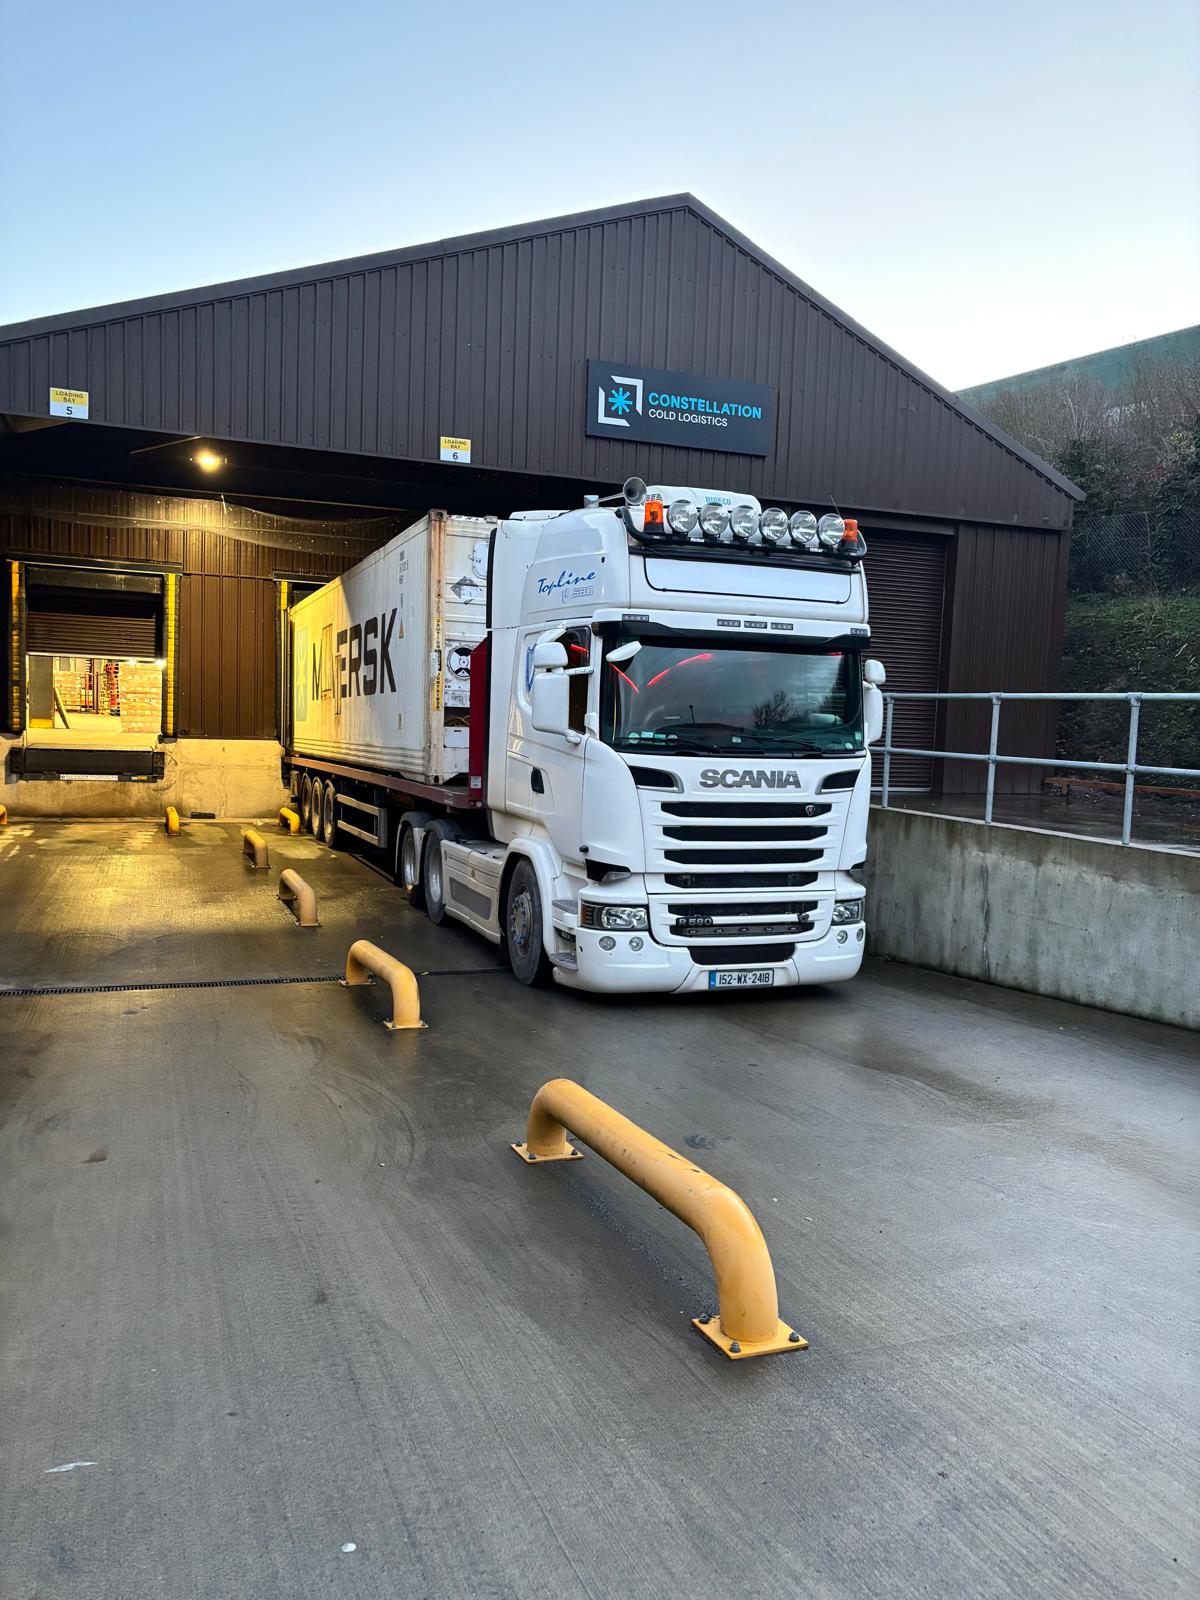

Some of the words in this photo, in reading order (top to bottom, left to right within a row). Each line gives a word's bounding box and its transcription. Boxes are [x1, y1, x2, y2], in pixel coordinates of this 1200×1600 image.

[55, 390, 84, 399] LOADING
[66, 406, 73, 415] 5
[648, 392, 762, 419] CONSTELLATION
[648, 408, 676, 420] COLD
[678, 412, 728, 427] LOGISTICS
[452, 452, 459, 460] 6
[537, 570, 596, 597] Topline
[312, 607, 398, 701] MERSK
[699, 768, 802, 789] SCANIA
[679, 918, 687, 926] R
[688, 917, 713, 926] 580
[719, 972, 770, 985] 152-WX-2418
